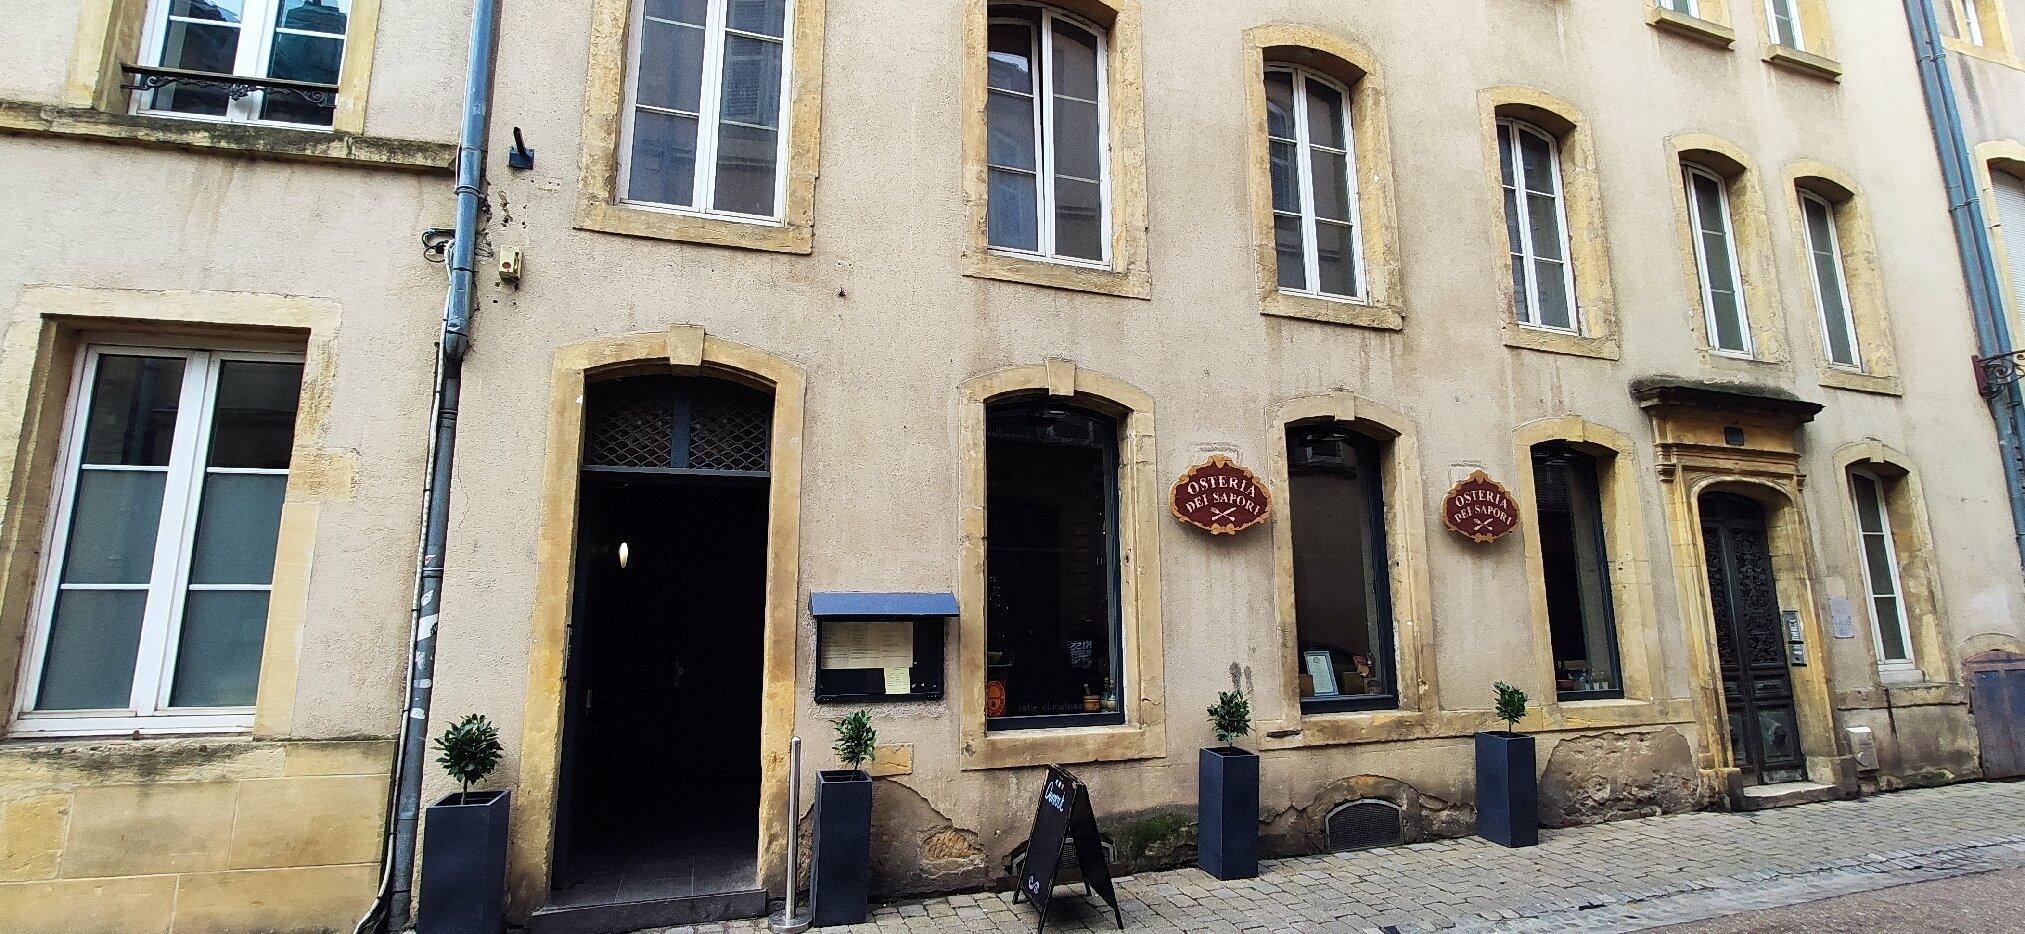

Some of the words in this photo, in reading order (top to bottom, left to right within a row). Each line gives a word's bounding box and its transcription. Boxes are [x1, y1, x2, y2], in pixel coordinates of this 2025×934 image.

[1187, 475, 1256, 497] OSTERIA
[1185, 494, 1209, 514] DEI
[1212, 491, 1261, 516] SAPORI
[1455, 490, 1507, 510] OSTERIA
[1454, 506, 1472, 523] DEI
[1474, 504, 1512, 525] SAPORI
